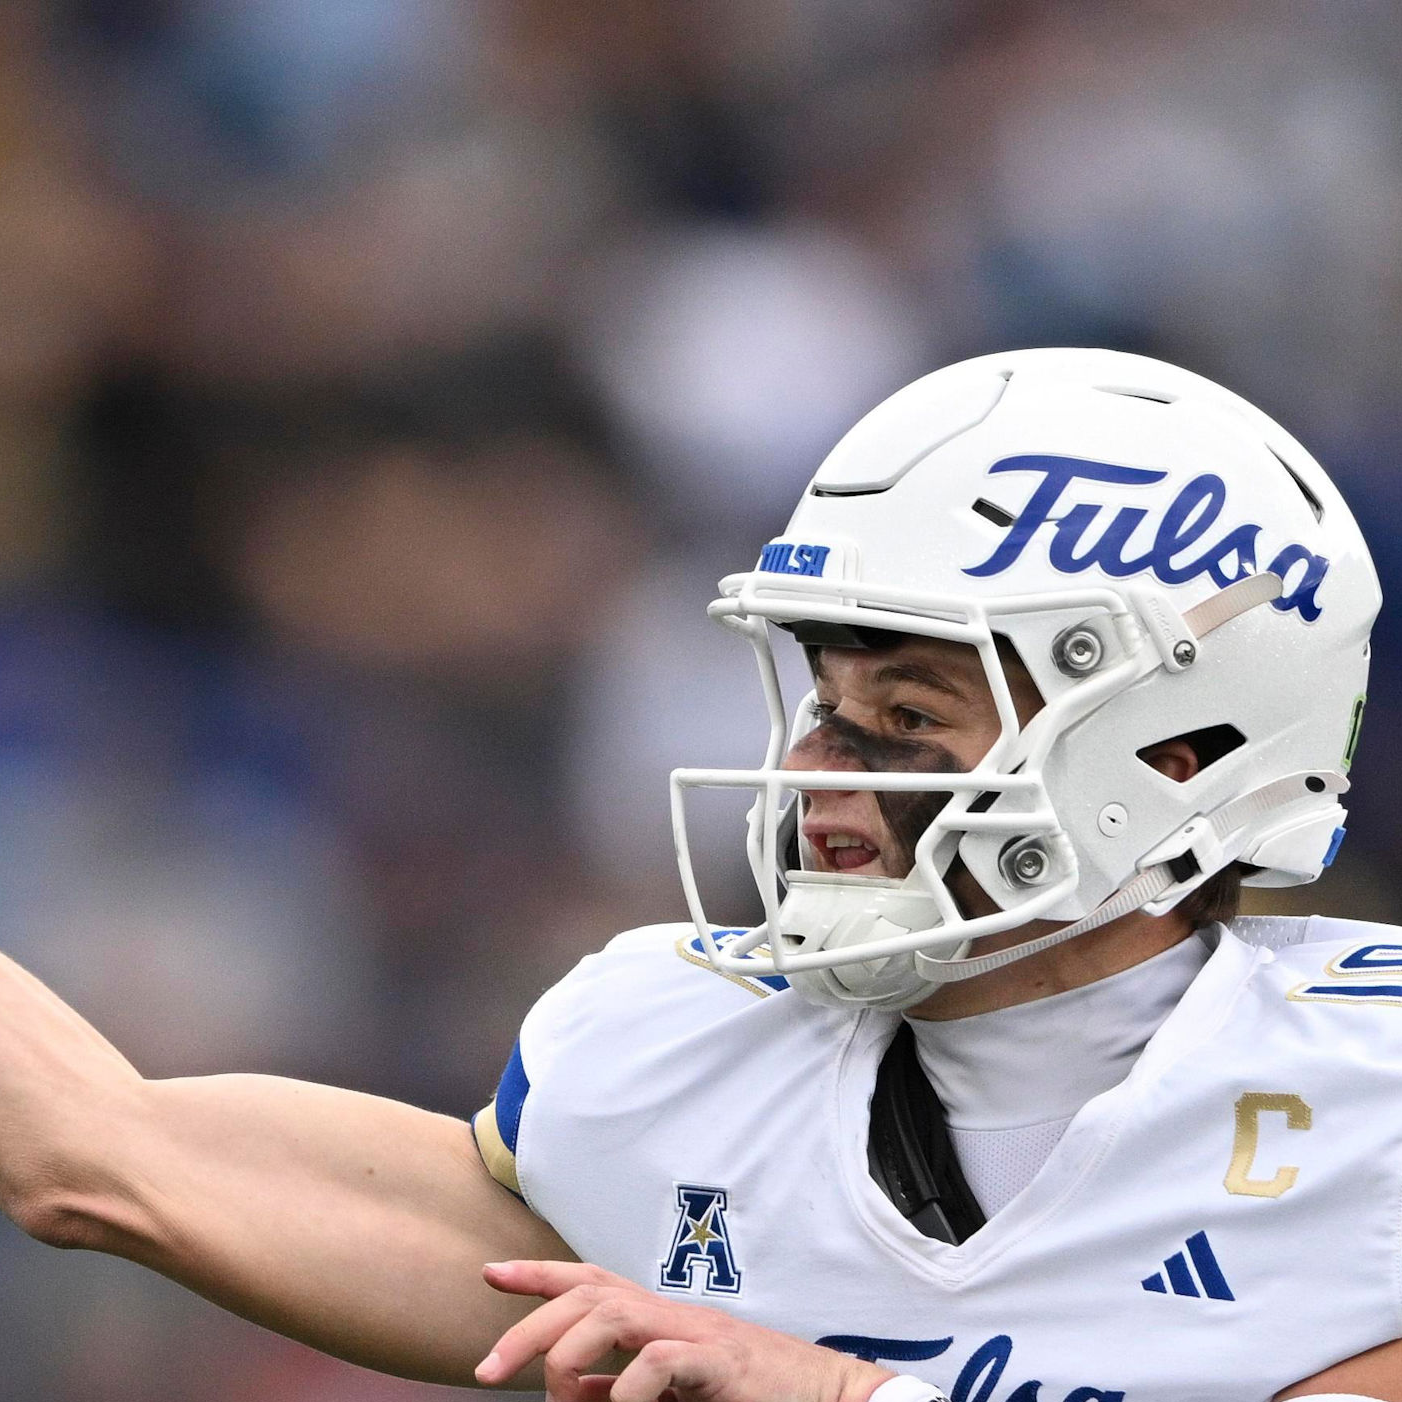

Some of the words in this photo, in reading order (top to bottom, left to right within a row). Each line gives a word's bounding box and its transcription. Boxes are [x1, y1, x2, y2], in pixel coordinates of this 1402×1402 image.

[759, 543, 830, 577] TULSA
[960, 454, 1330, 622] Tulsa
[1222, 1091, 1312, 1198] C
